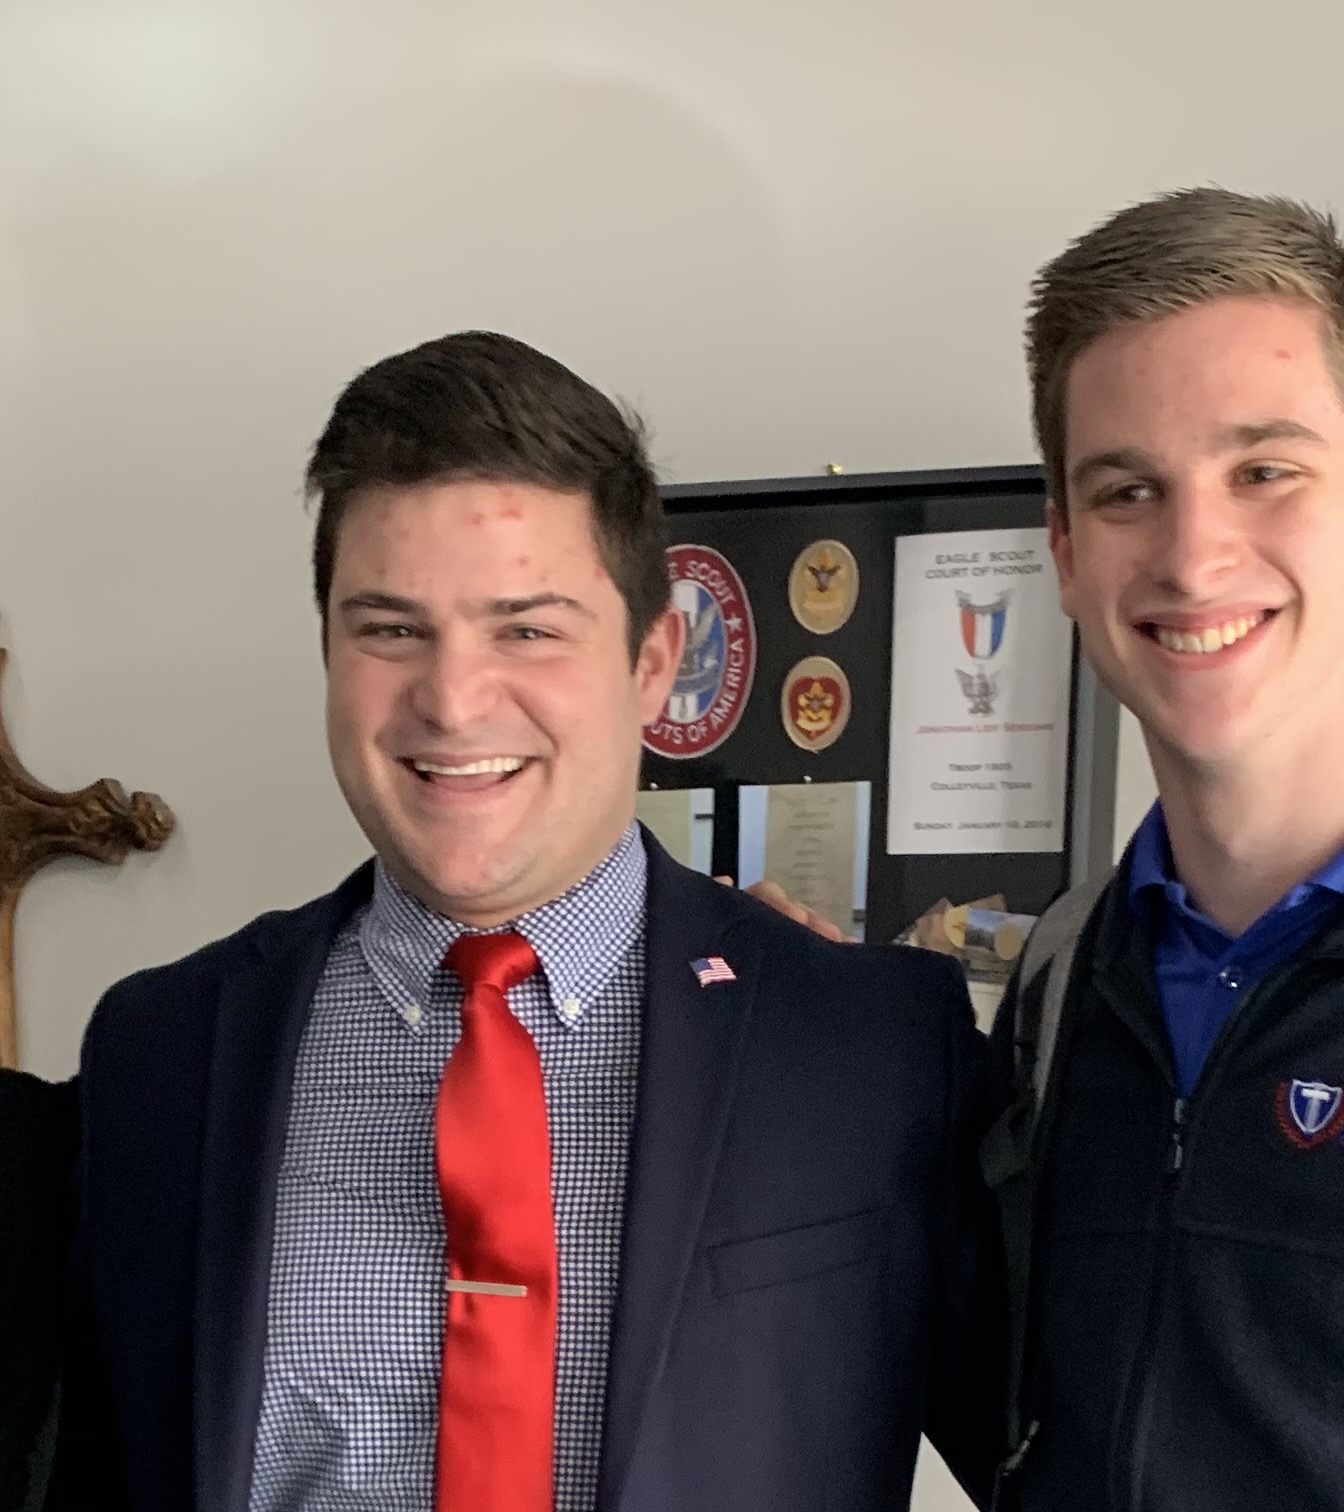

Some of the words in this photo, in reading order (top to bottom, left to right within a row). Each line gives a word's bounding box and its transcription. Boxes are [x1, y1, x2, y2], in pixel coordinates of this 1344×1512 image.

[924, 567, 969, 580] COURT
[972, 566, 990, 577] OF
[993, 564, 1044, 576] HONOR
[935, 551, 981, 565] EAGLE
[988, 549, 1035, 562] SCOUT
[684, 559, 736, 605] SCOUT
[650, 721, 683, 745] UTS
[686, 721, 708, 743] OF
[709, 637, 745, 731] AMERICA
